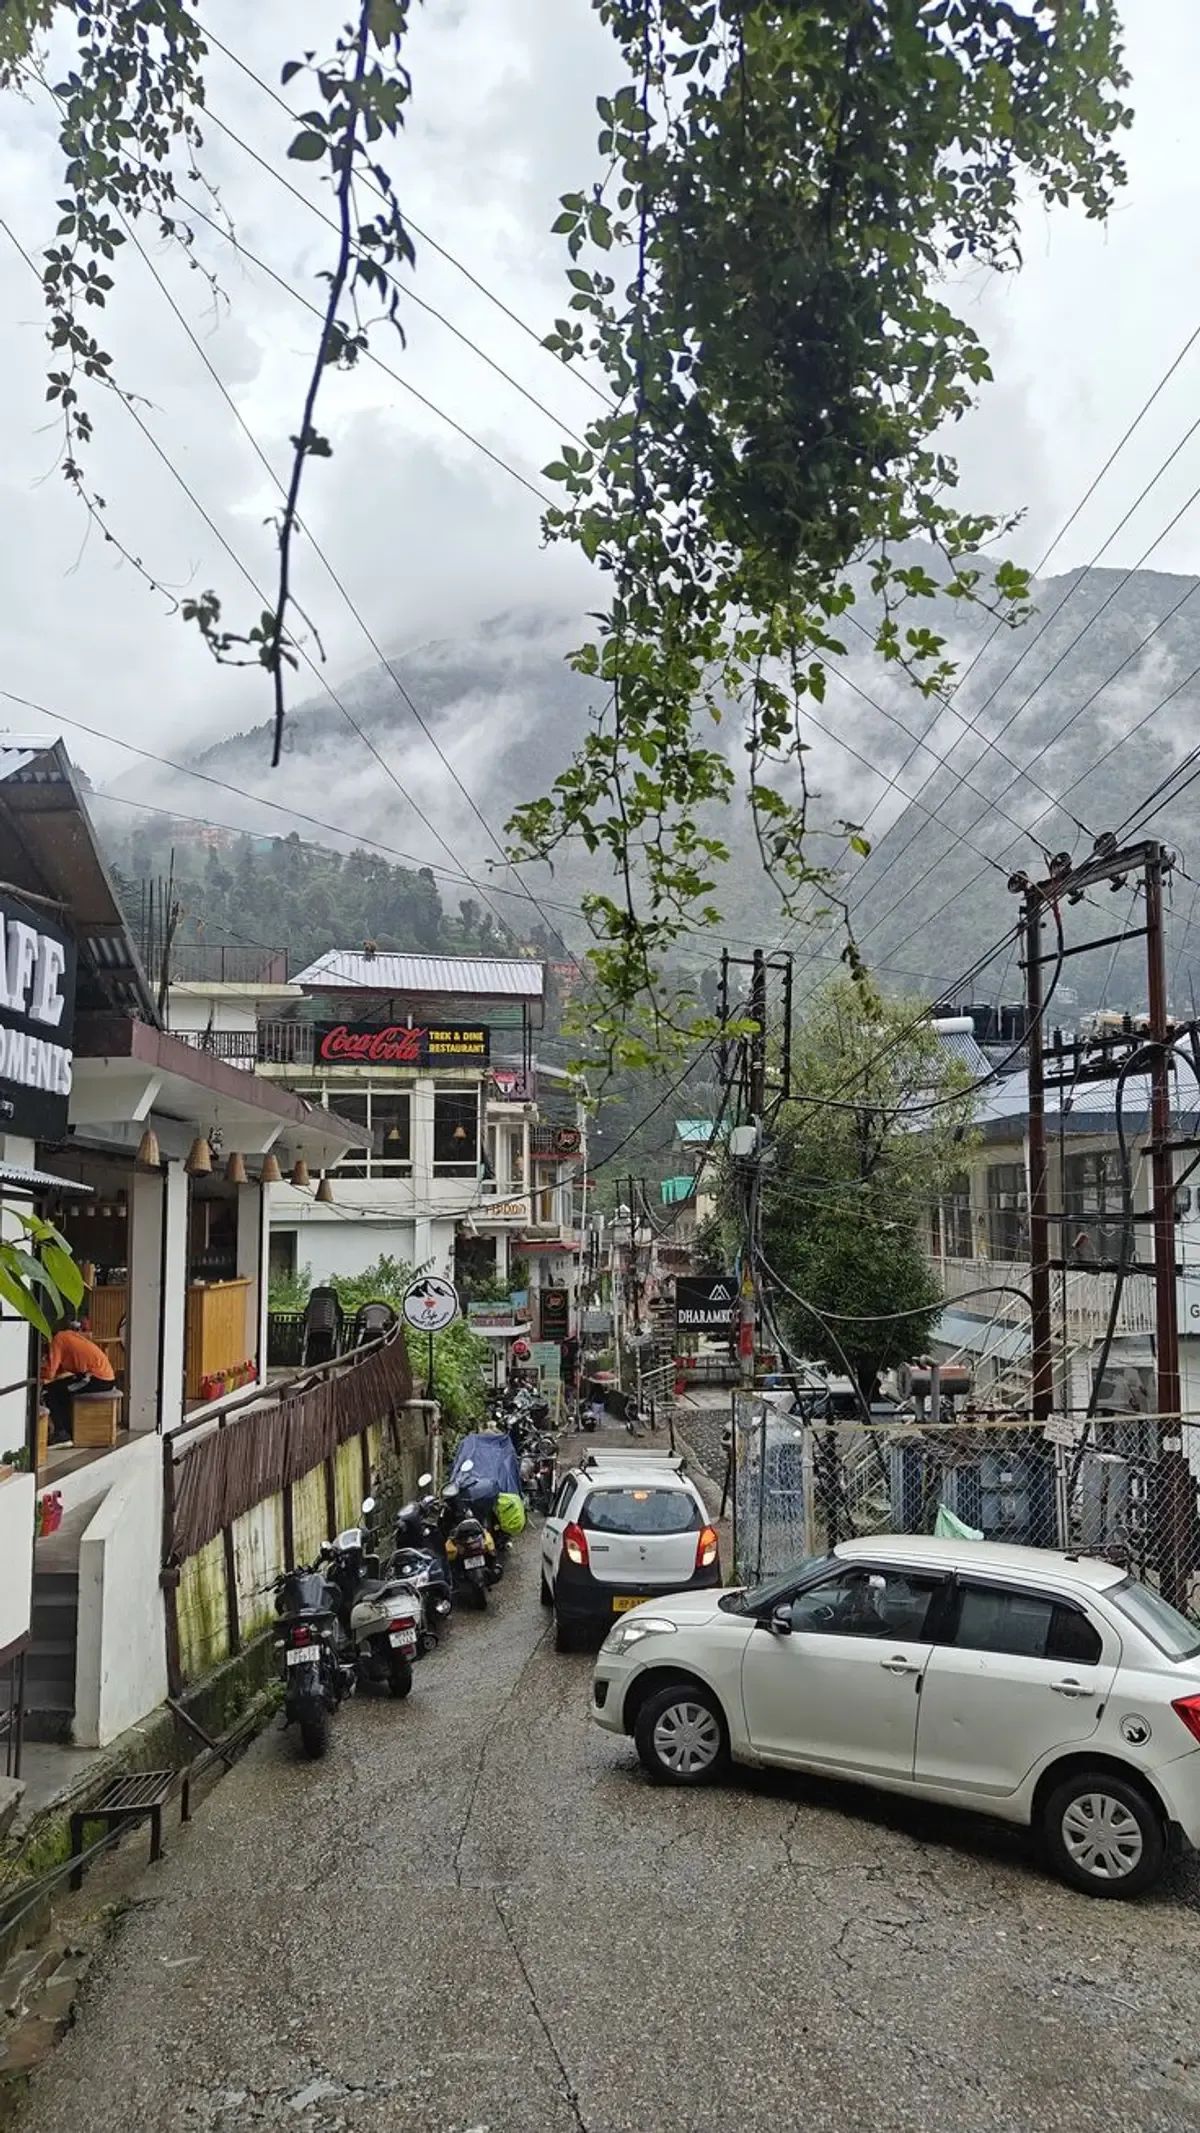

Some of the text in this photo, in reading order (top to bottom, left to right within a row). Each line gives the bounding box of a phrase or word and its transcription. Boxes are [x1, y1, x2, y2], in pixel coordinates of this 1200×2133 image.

[429, 1031, 484, 1041] TREK & DINE
[429, 1043, 486, 1054] RESTAURANT
